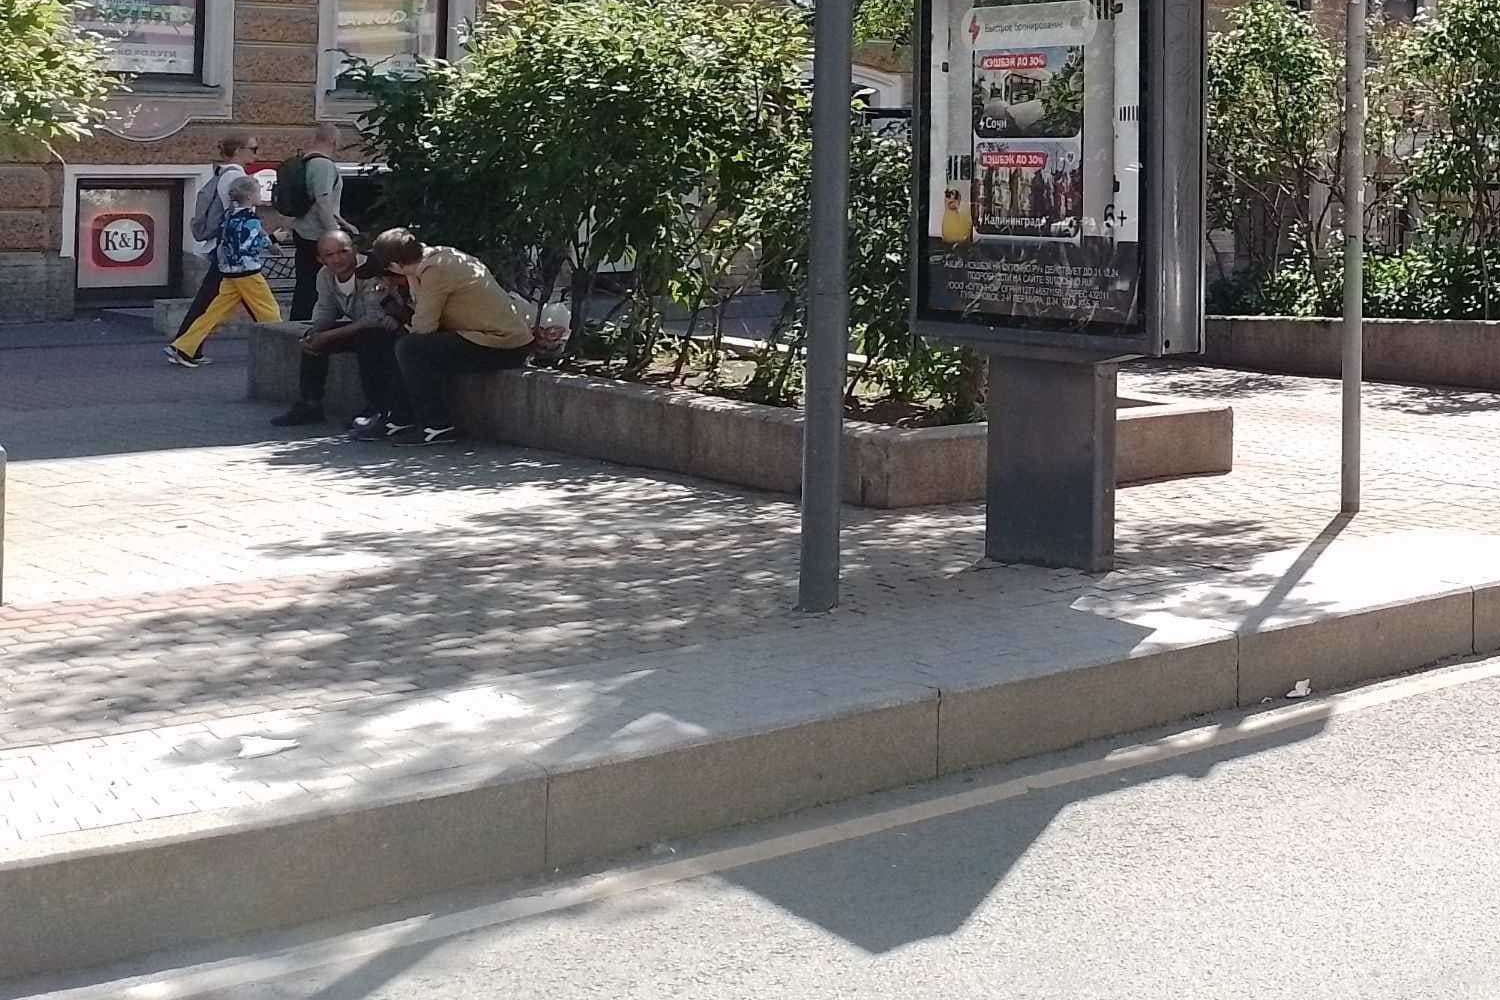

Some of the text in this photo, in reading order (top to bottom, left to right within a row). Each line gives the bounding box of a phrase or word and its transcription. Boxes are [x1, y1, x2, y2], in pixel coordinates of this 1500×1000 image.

[983, 56, 1015, 69] КЭШБЭК
[1016, 56, 1028, 67] ДО
[985, 117, 1007, 129] Сочи
[983, 153, 1015, 166] КЭШБЭК
[1016, 153, 1028, 165] ДО
[984, 213, 1042, 228] Калининград
[103, 229, 146, 251] К&Б
